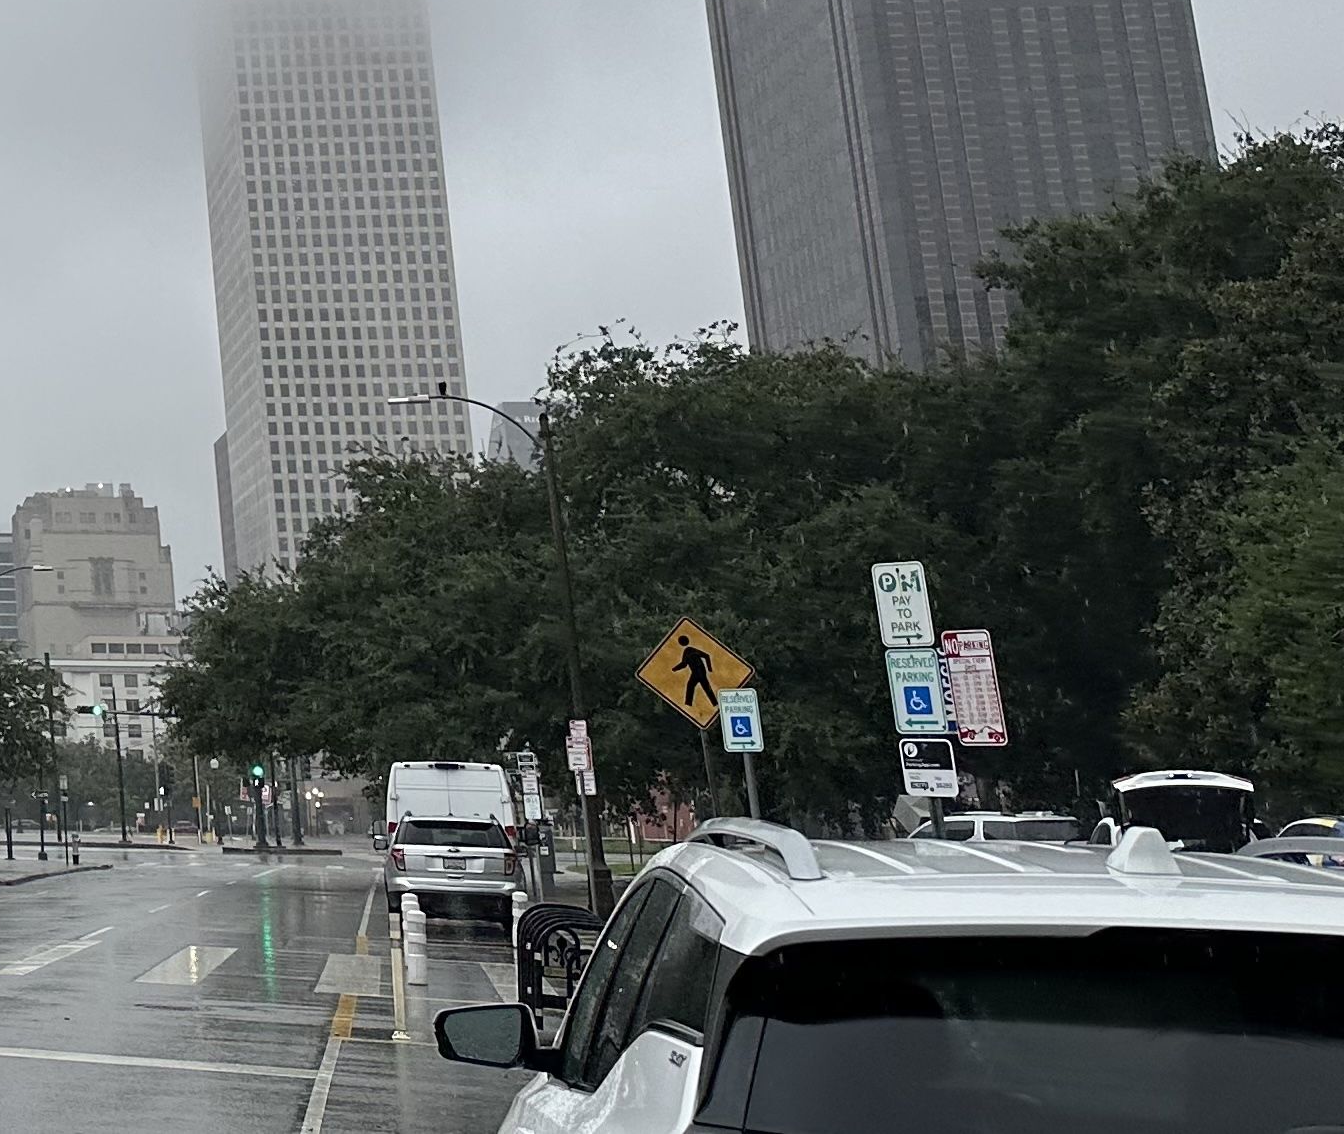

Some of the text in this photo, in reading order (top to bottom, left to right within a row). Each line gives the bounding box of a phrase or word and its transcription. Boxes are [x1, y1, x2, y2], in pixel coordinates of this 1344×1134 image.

[892, 595, 911, 606] PAY
[896, 608, 913, 619] TO
[890, 621, 922, 633] PARK
[944, 638, 959, 655] NO
[889, 657, 935, 668] RESERVED
[895, 671, 934, 683] PARKING
